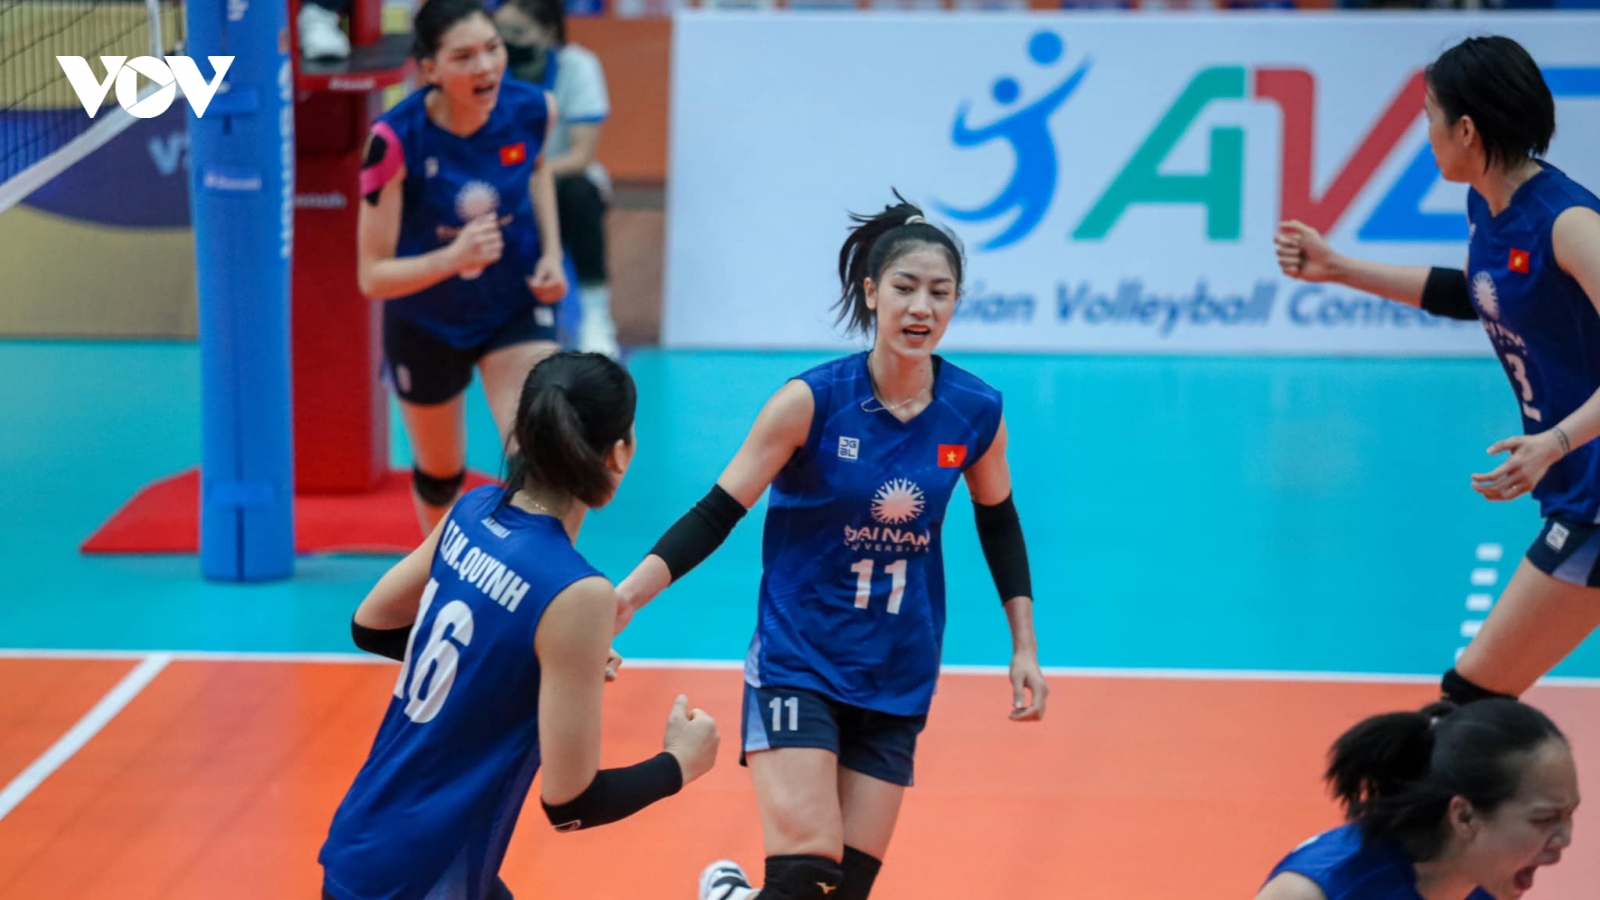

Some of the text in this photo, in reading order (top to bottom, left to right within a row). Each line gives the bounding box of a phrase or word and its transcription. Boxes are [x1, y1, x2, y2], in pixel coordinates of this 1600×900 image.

[1055, 277, 1275, 337] Volleyball
[850, 558, 908, 615] 11
[393, 577, 475, 724] 16
[768, 696, 799, 732] 11
